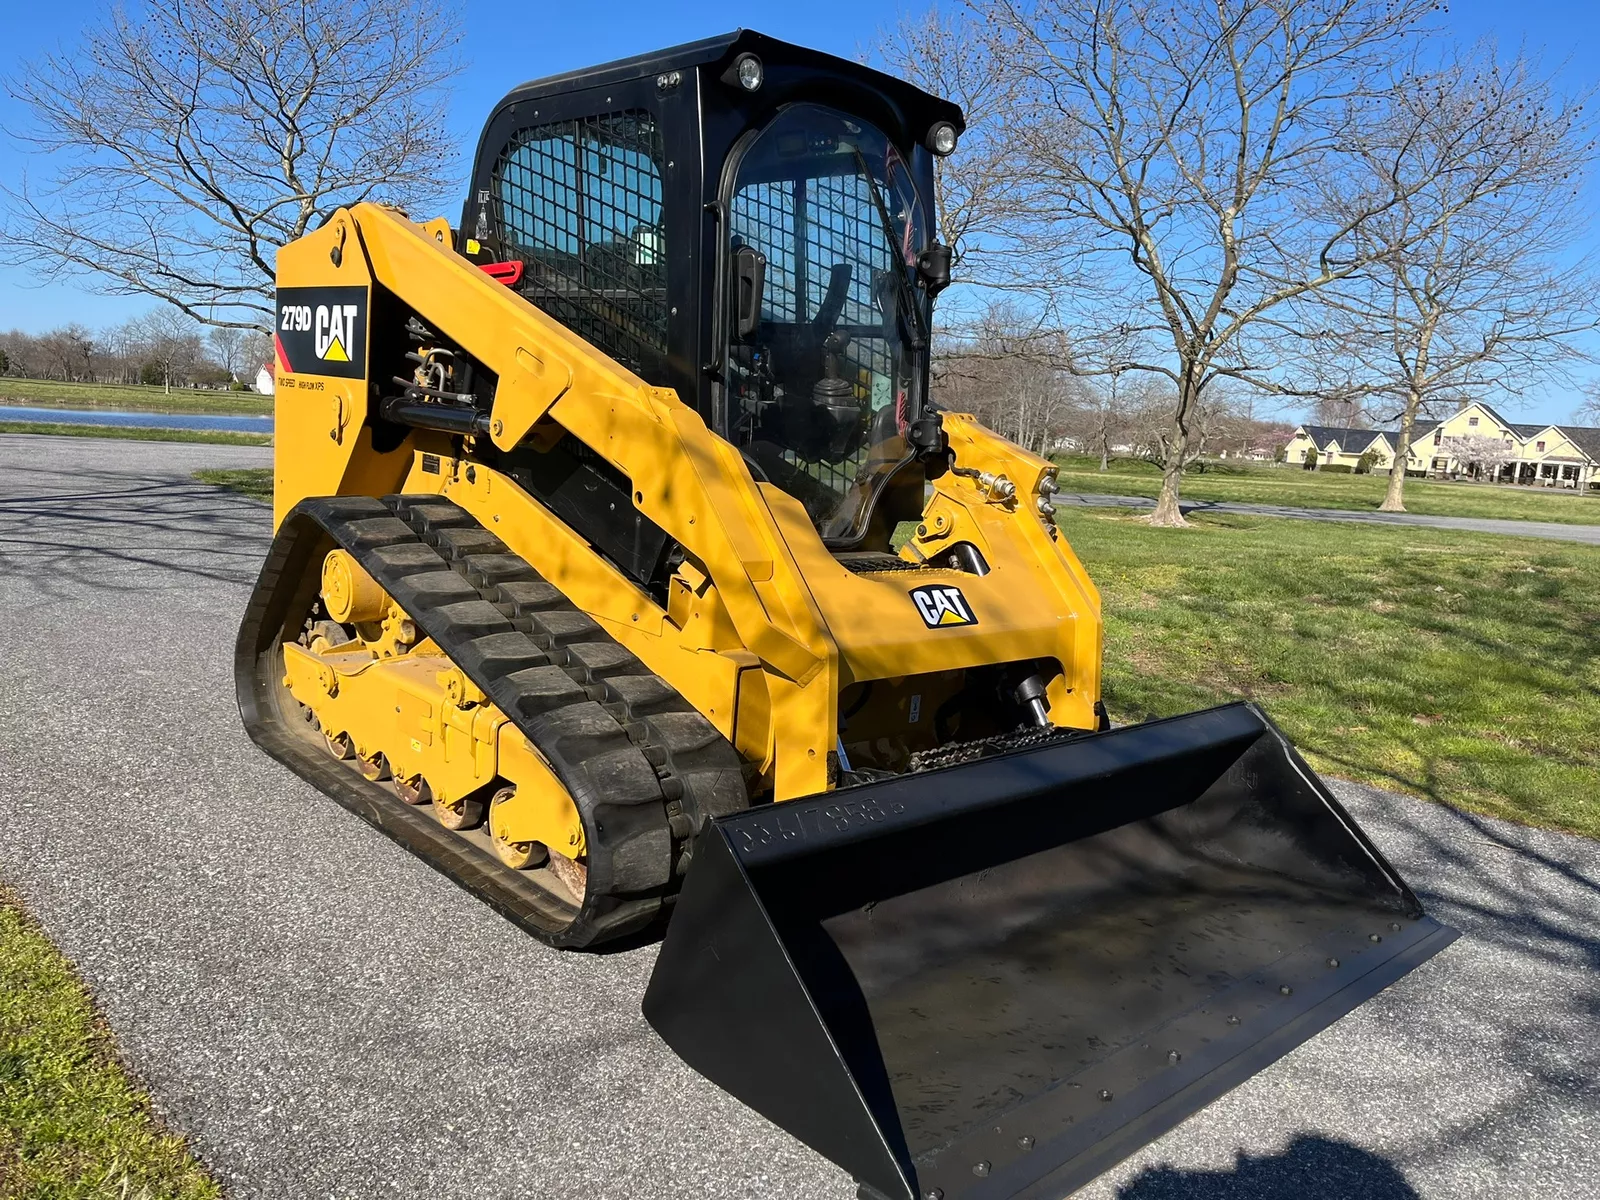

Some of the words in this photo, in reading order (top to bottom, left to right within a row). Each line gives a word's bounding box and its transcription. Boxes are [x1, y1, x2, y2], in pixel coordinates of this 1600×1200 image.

[281, 305, 311, 331] 279D
[315, 305, 357, 361] CAT
[315, 381, 325, 391] XPS
[913, 588, 971, 625] CAT
